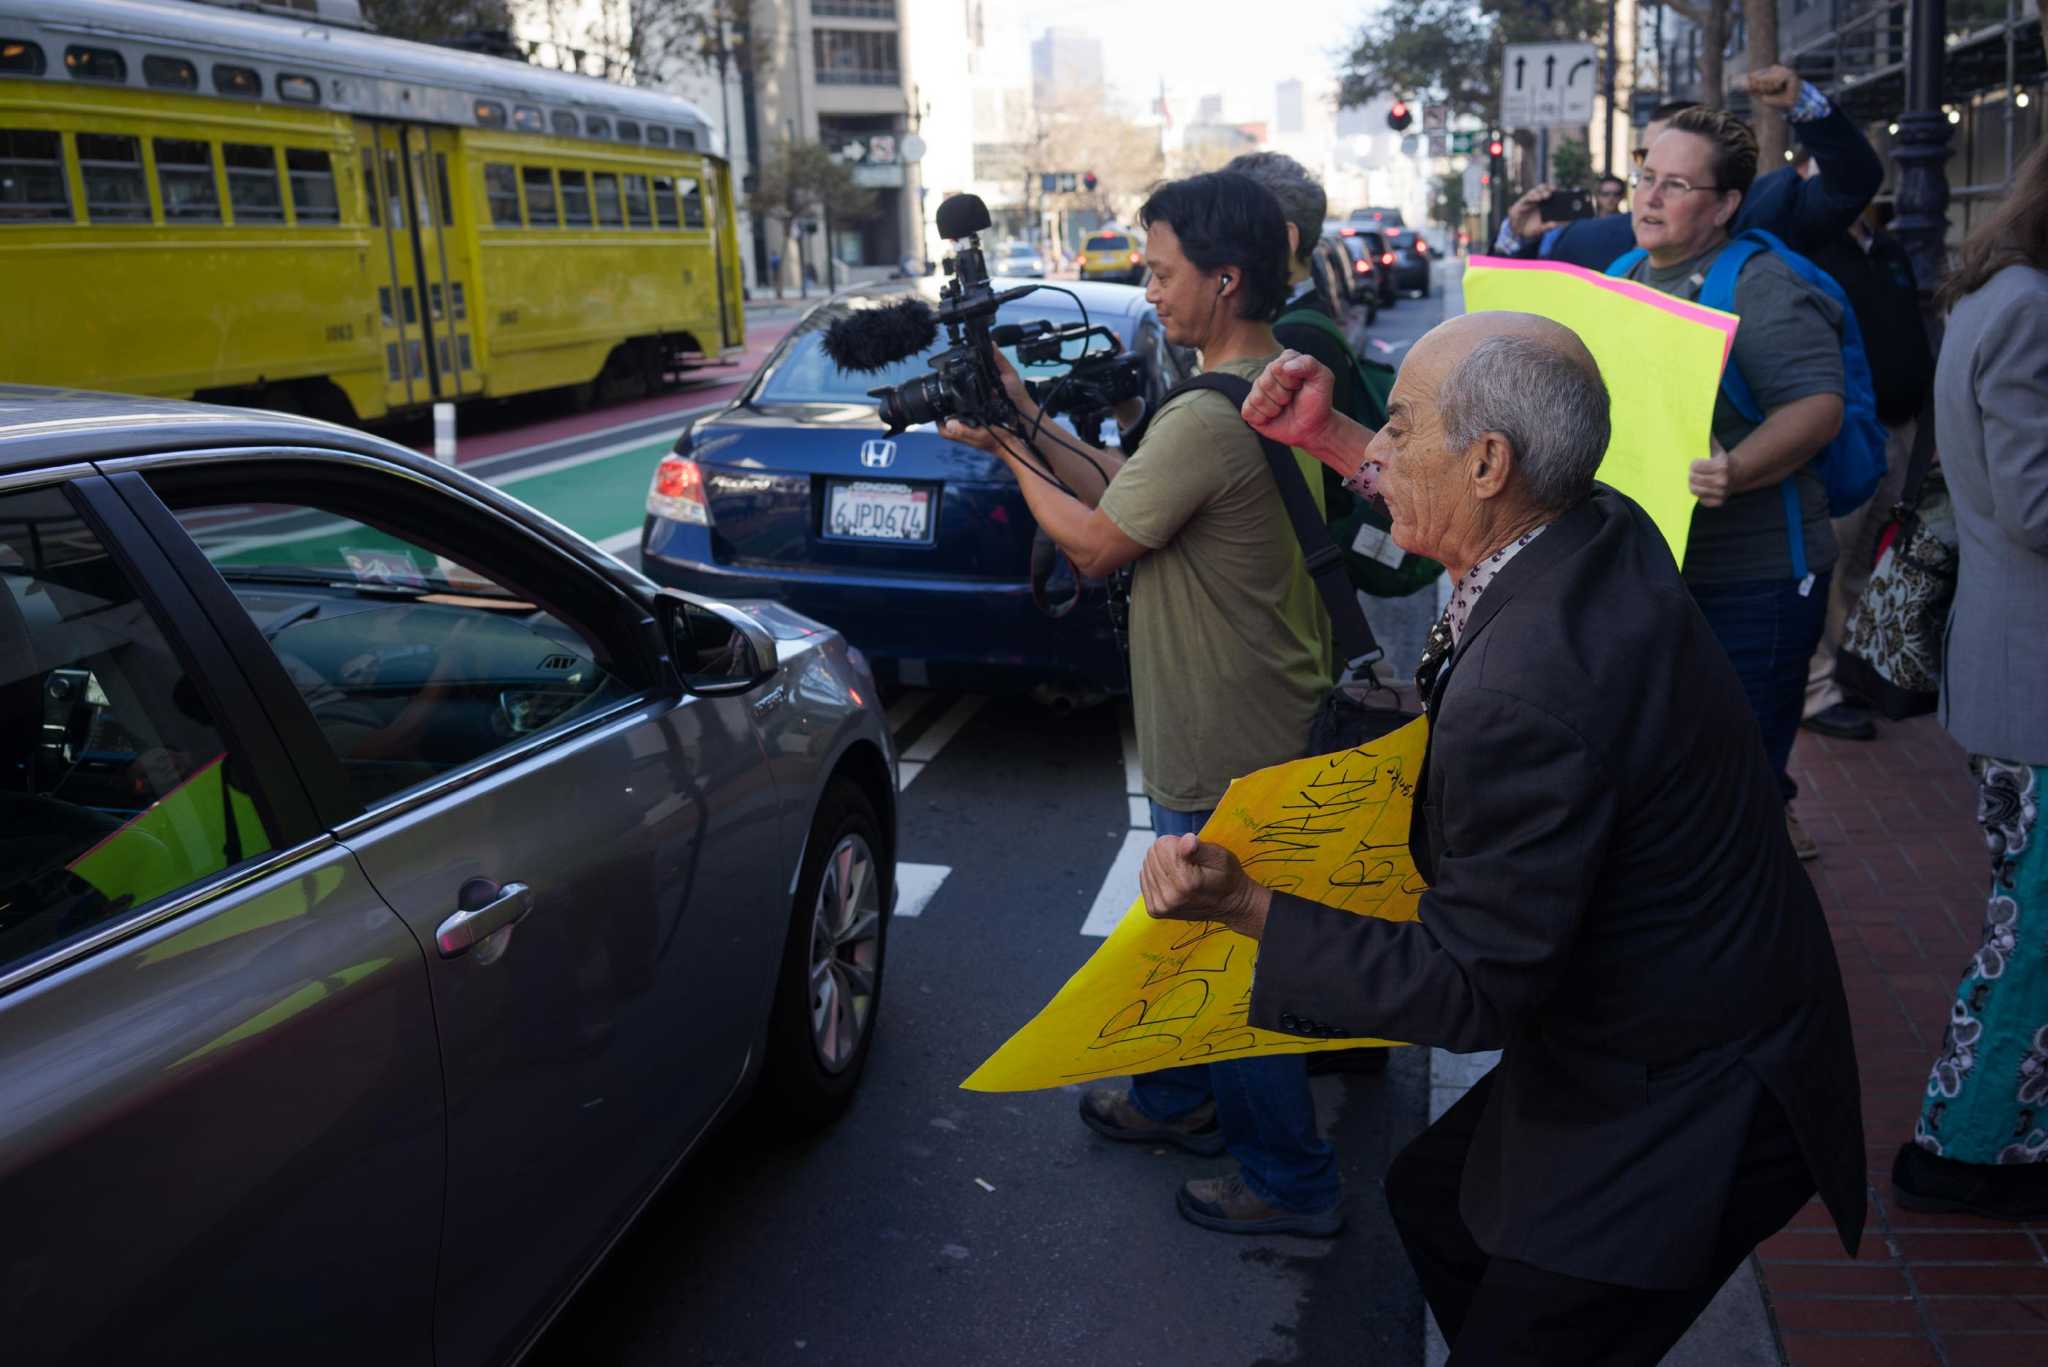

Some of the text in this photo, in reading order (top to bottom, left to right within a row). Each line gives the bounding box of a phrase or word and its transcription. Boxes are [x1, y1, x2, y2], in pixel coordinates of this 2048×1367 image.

[835, 502, 922, 531] 6JPD674
[1210, 750, 1379, 868] MAKES
[1328, 839, 1410, 887] BY
